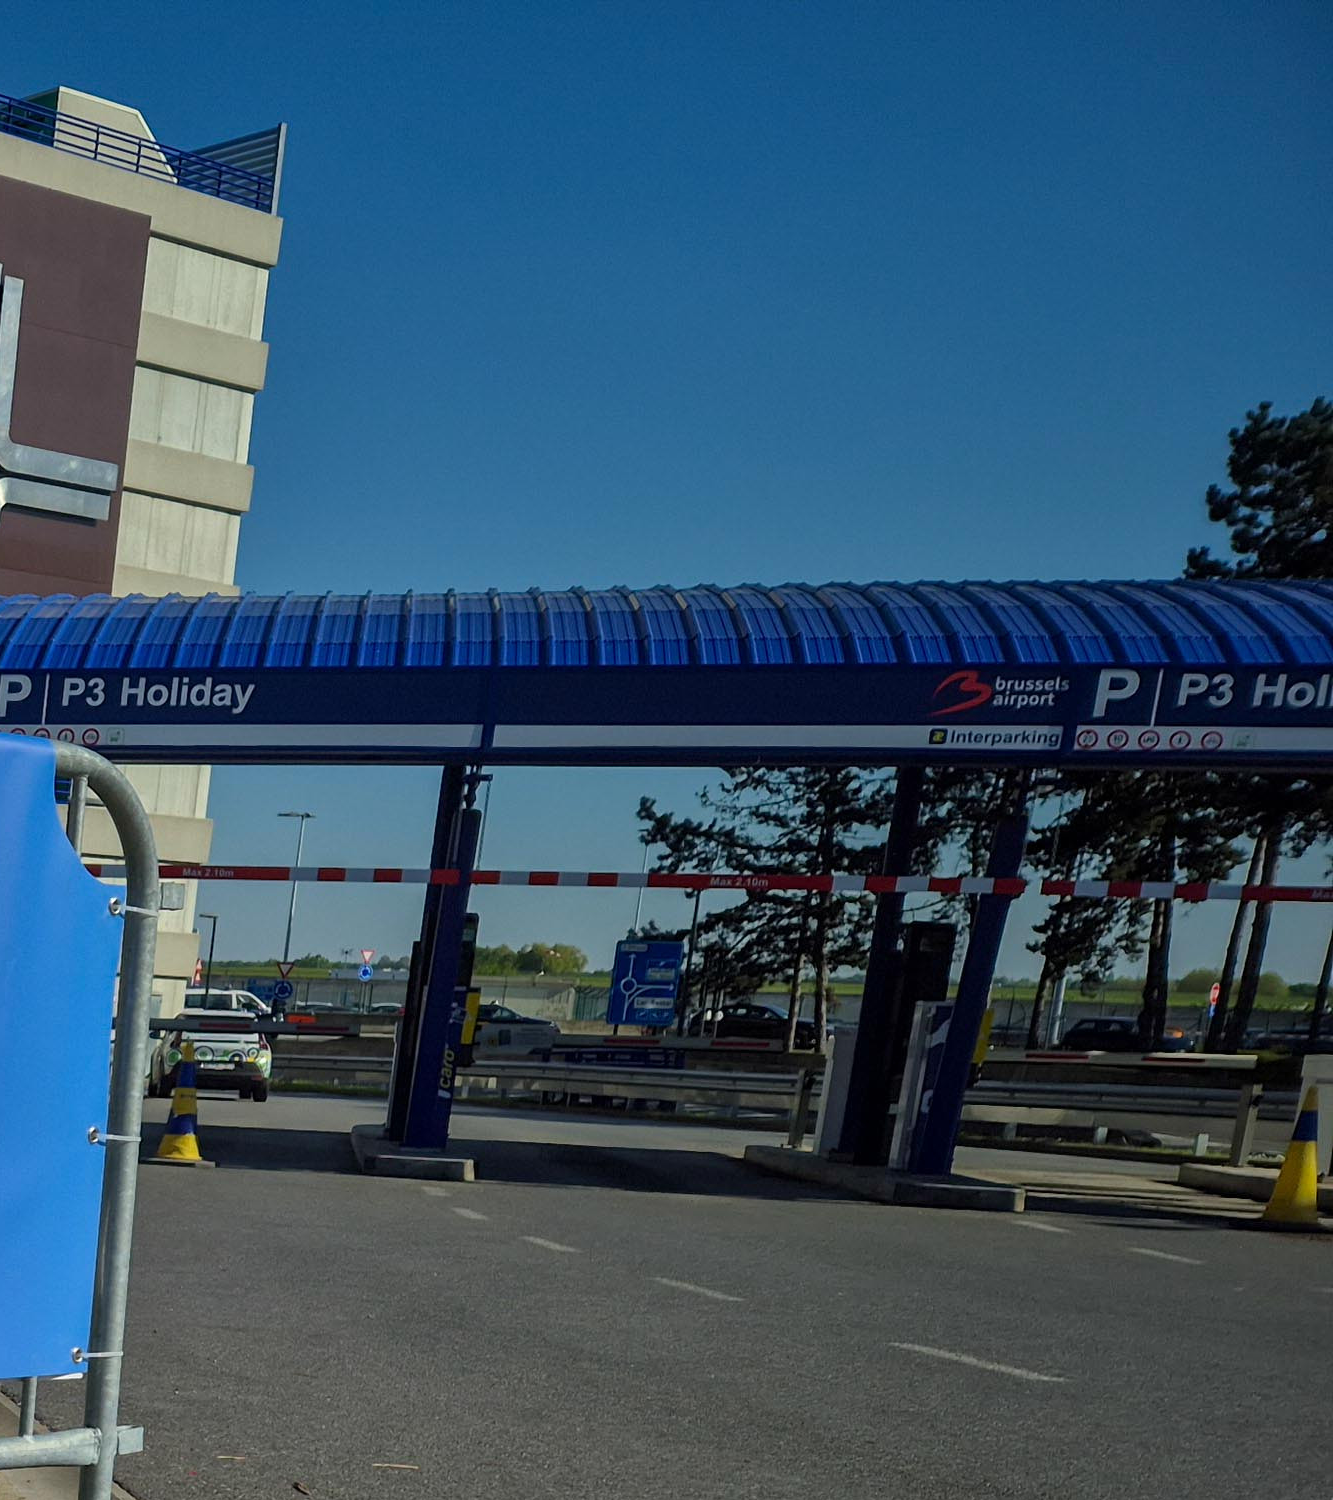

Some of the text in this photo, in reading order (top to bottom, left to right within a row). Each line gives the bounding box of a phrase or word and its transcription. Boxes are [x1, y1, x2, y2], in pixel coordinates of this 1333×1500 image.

[994, 675, 1070, 692] brussels
[61, 677, 106, 707] P3
[120, 676, 255, 714] Holiday
[992, 691, 1056, 710] airport
[1092, 668, 1141, 718] P
[1177, 672, 1234, 708] P3
[950, 729, 1061, 747] Interparking
[182, 868, 202, 878] Max
[709, 876, 733, 887] Max
